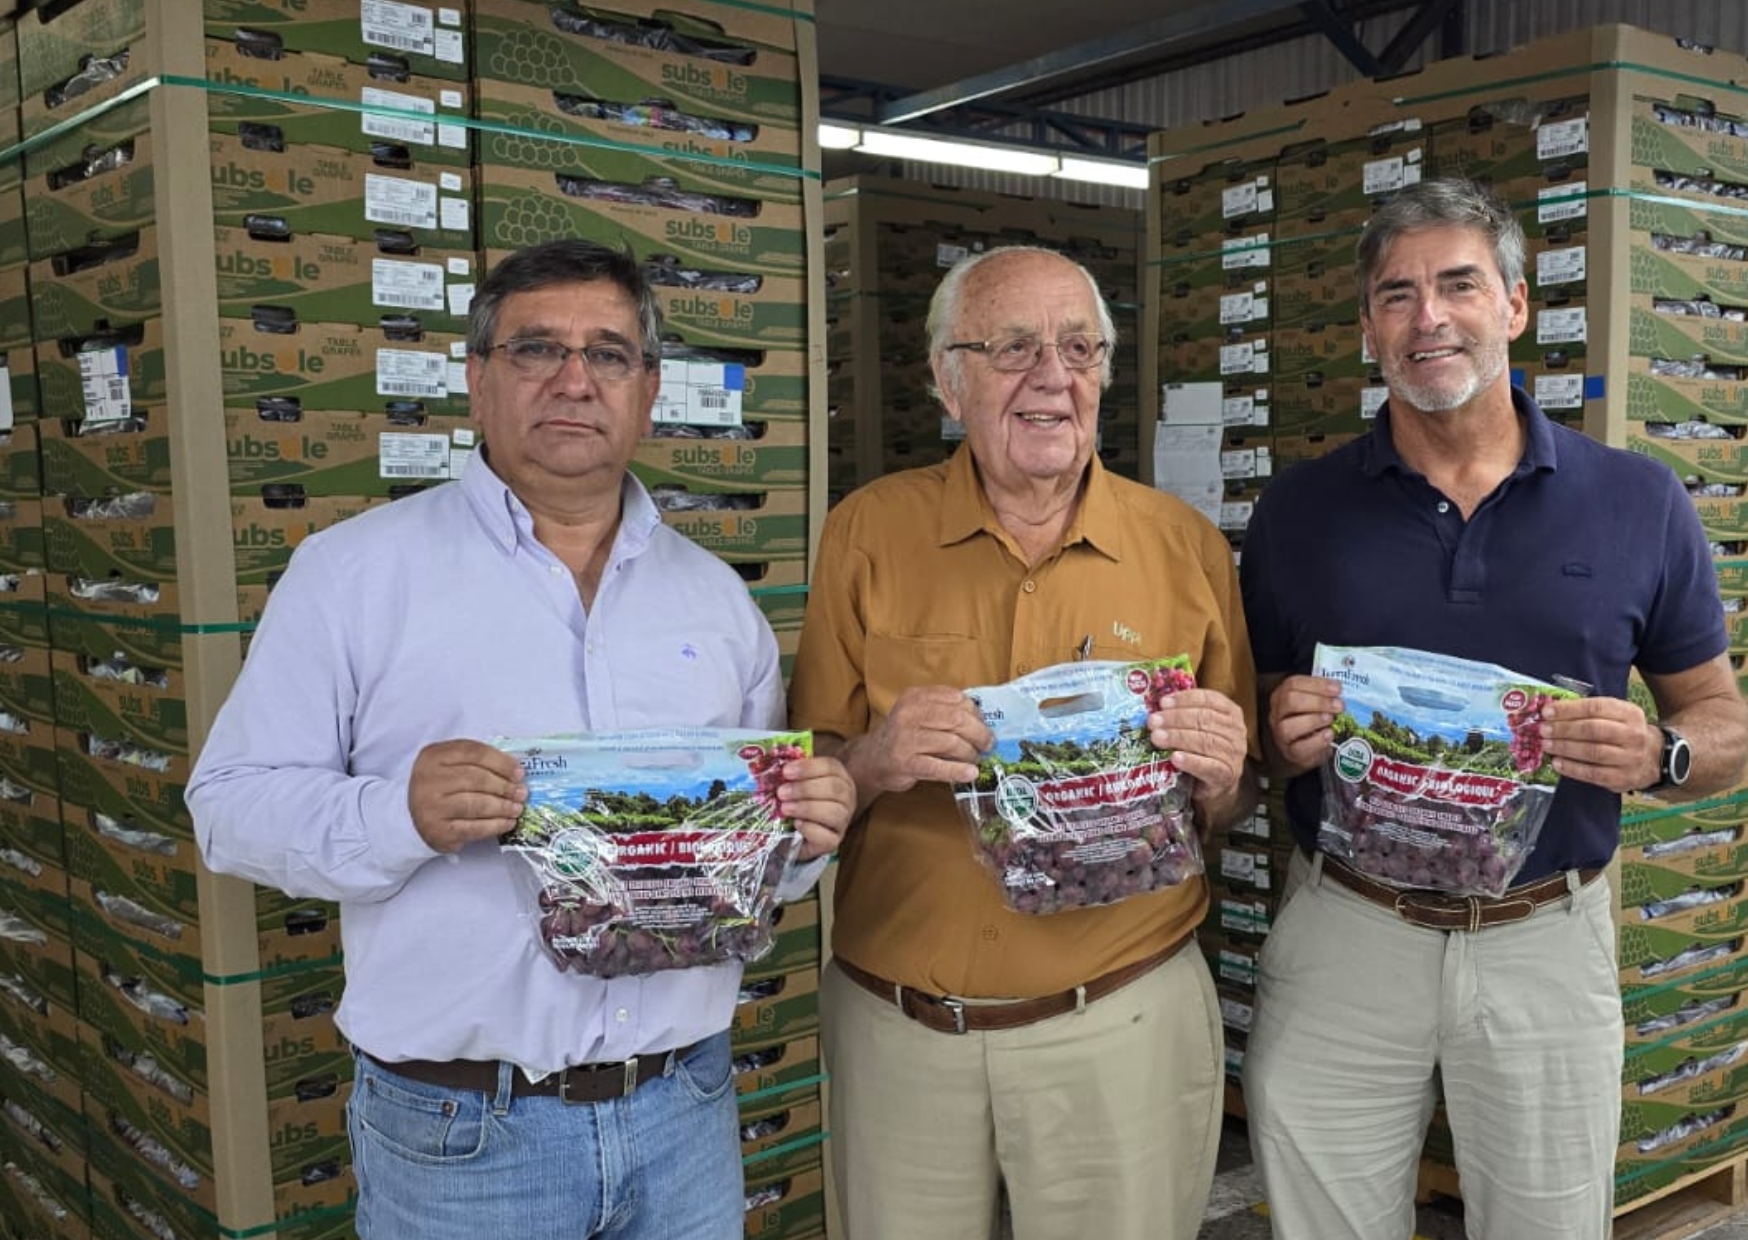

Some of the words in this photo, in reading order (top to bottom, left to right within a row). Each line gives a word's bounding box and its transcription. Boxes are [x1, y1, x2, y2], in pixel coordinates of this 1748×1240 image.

[211, 162, 315, 195] ubsole
[216, 250, 320, 280] ubsole
[221, 347, 324, 373] ubsole
[227, 435, 328, 459] ubsole
[672, 445, 754, 467] subsole
